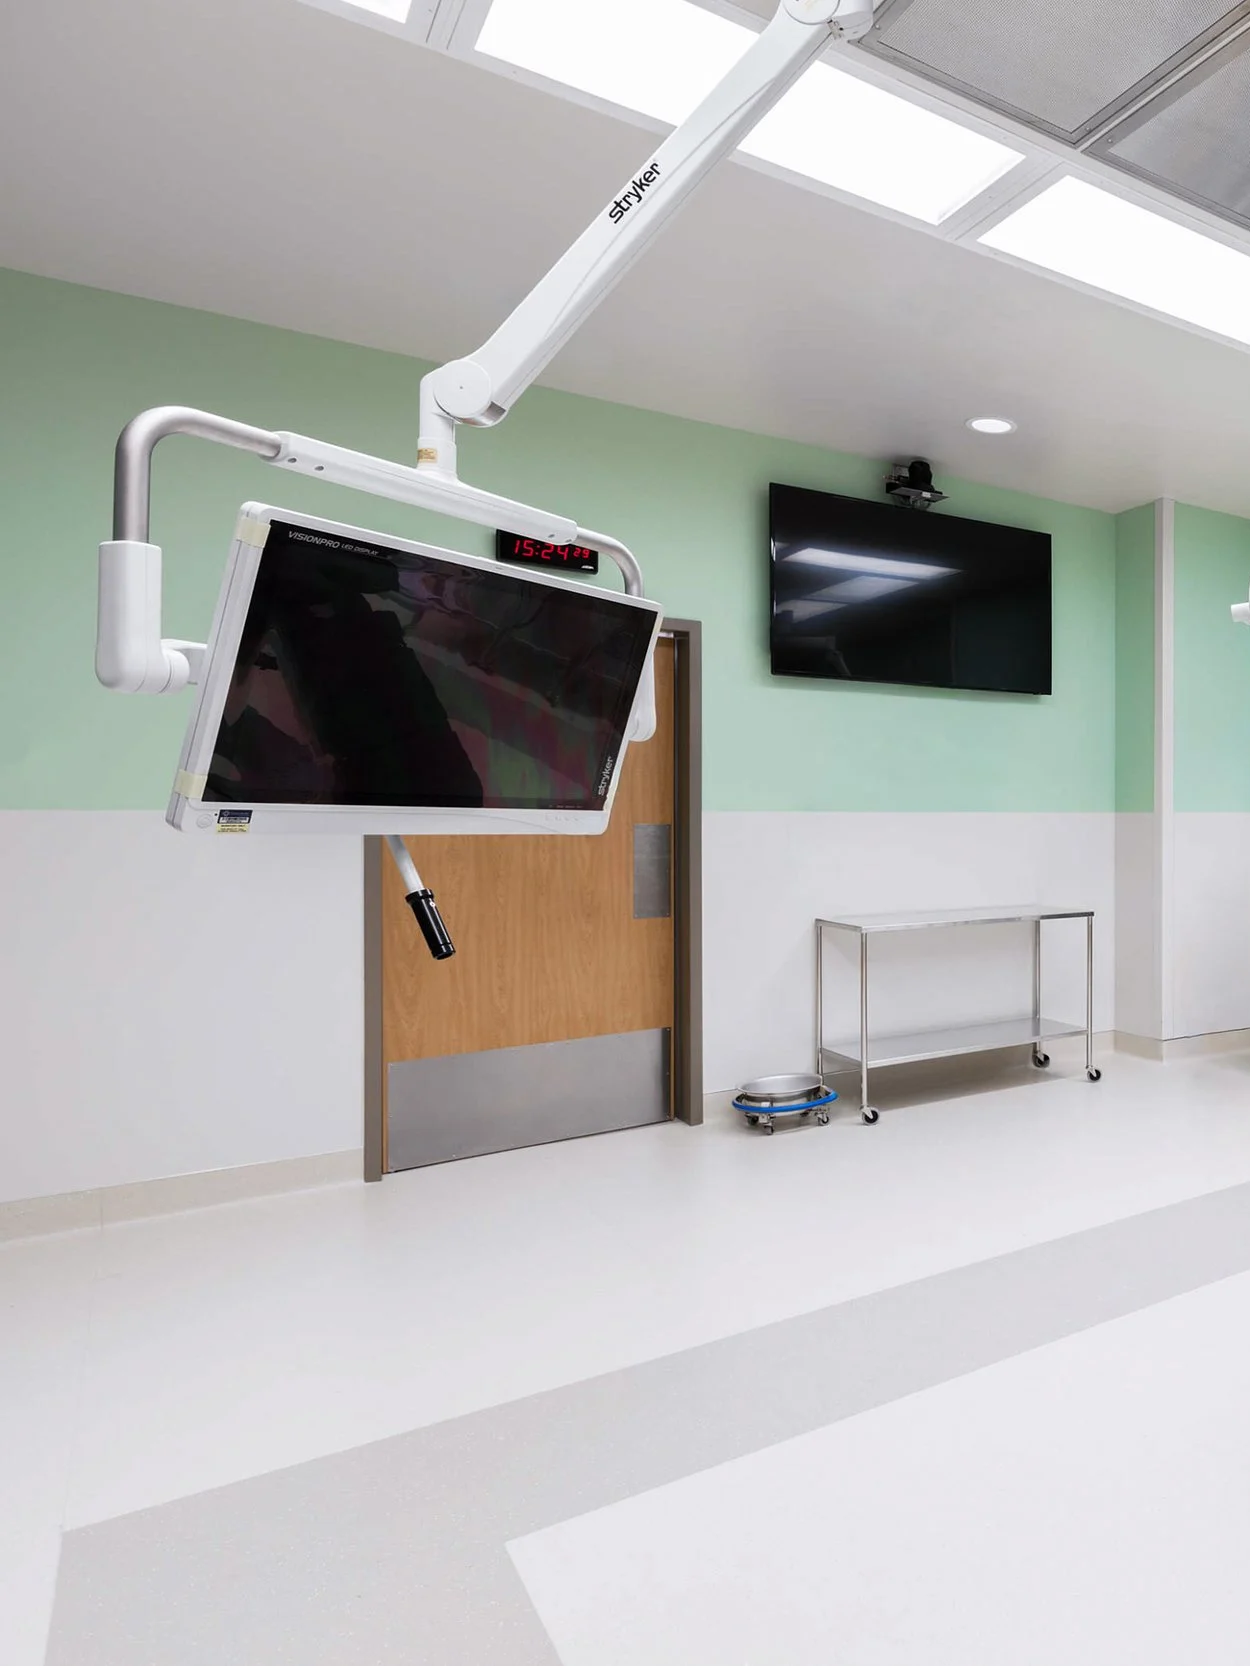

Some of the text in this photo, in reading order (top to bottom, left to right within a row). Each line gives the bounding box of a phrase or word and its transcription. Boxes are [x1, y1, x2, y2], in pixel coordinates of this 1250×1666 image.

[608, 162, 661, 224] stryker
[288, 530, 340, 549] VISIONPRO
[514, 539, 569, 560] 15:24
[598, 755, 614, 796] stryker
